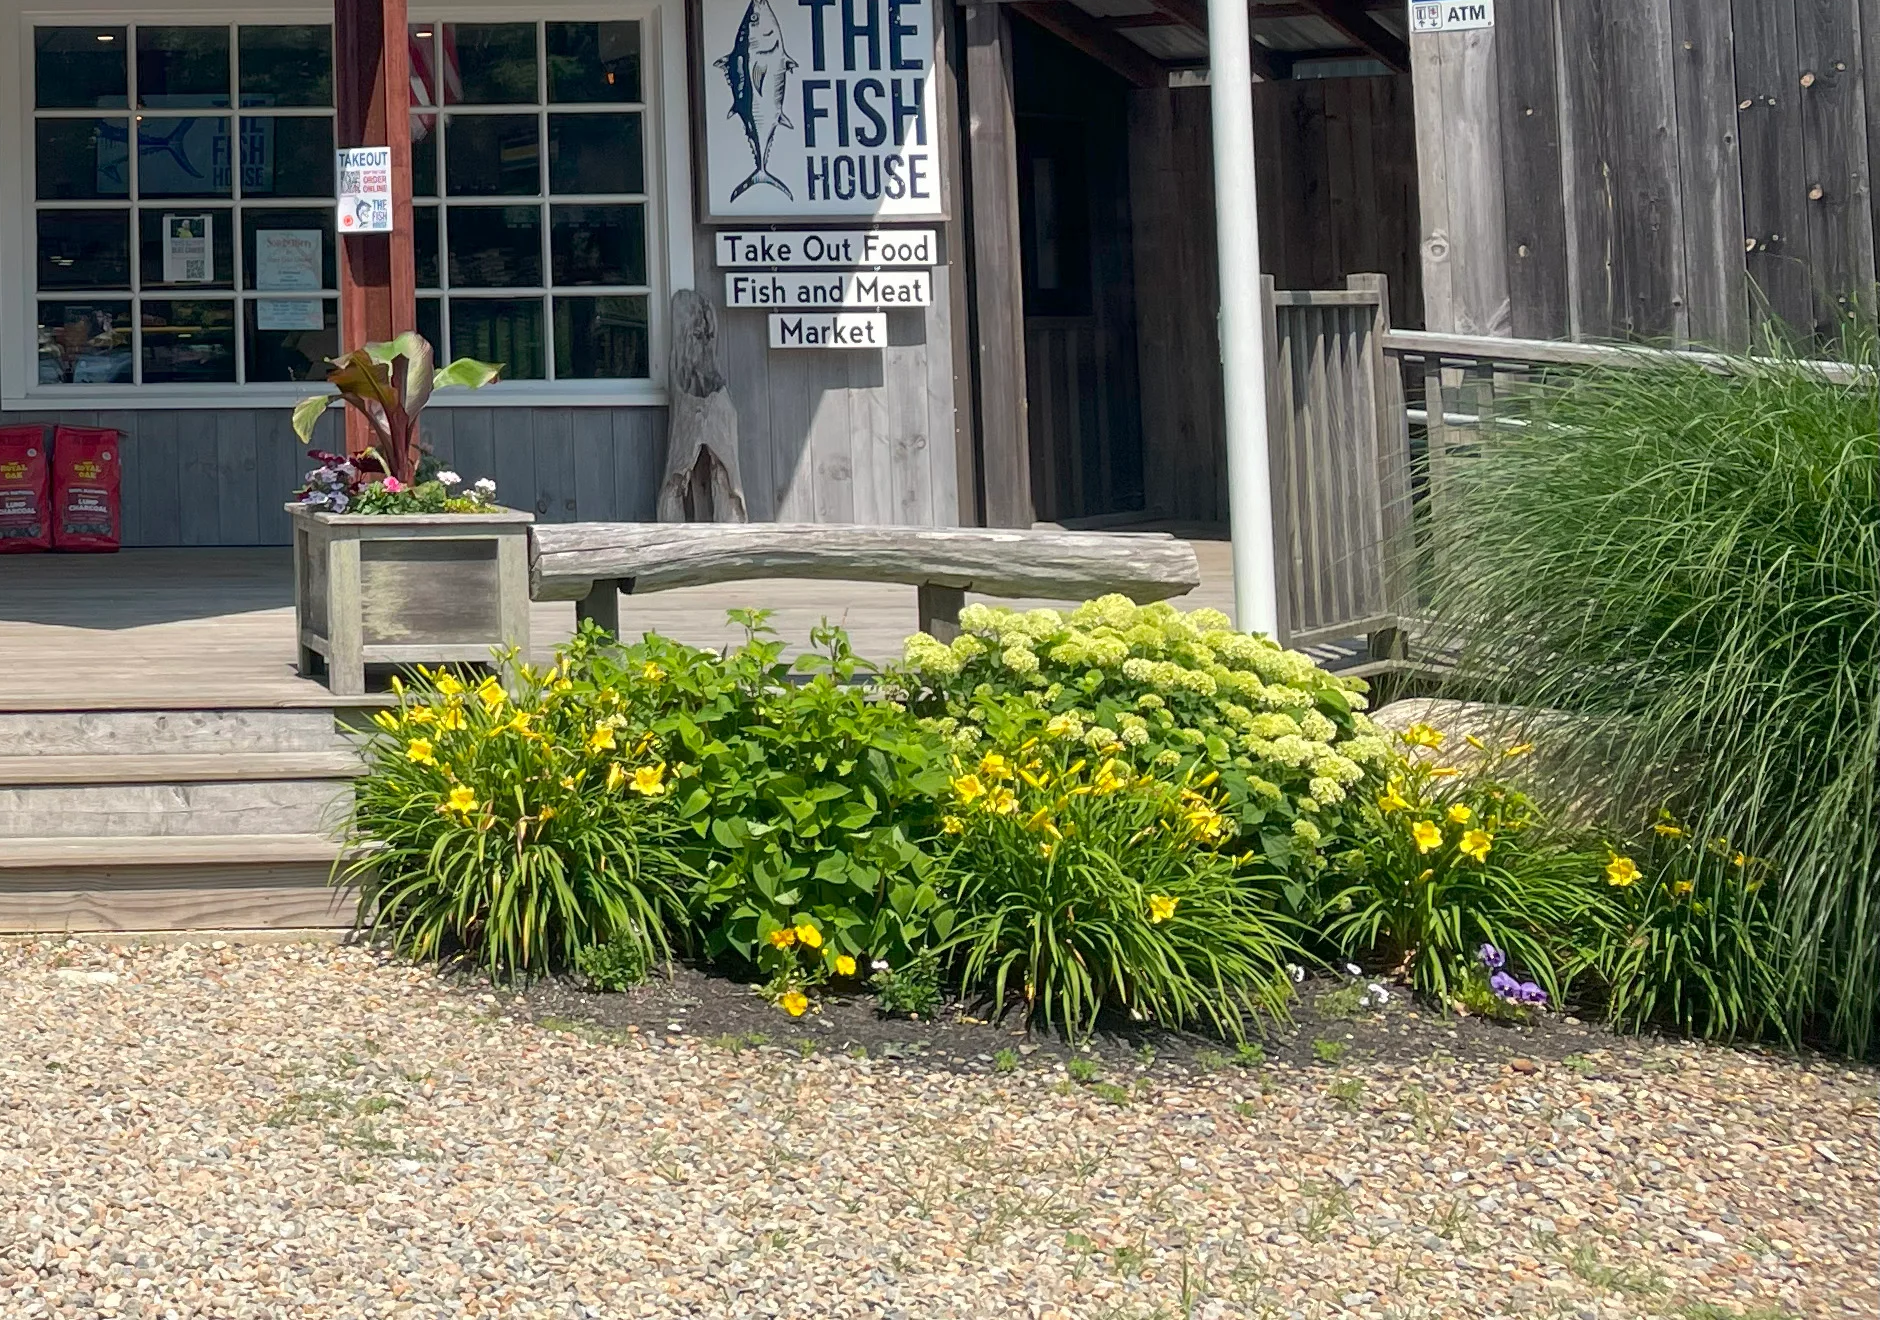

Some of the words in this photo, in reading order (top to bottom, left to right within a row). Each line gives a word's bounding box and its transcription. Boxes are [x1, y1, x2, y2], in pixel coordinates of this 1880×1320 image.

[1447, 4, 1486, 22] ATM
[802, 78, 927, 148] FISH
[339, 152, 388, 167] TAKEOUT
[806, 154, 931, 200] HOUSE
[372, 199, 387, 211] THE
[724, 235, 792, 262] Take
[803, 235, 852, 262] Out
[863, 235, 928, 262] Food
[733, 277, 786, 304] Fish
[797, 276, 843, 303] and
[856, 276, 922, 303] Meat
[780, 318, 876, 344] Market
